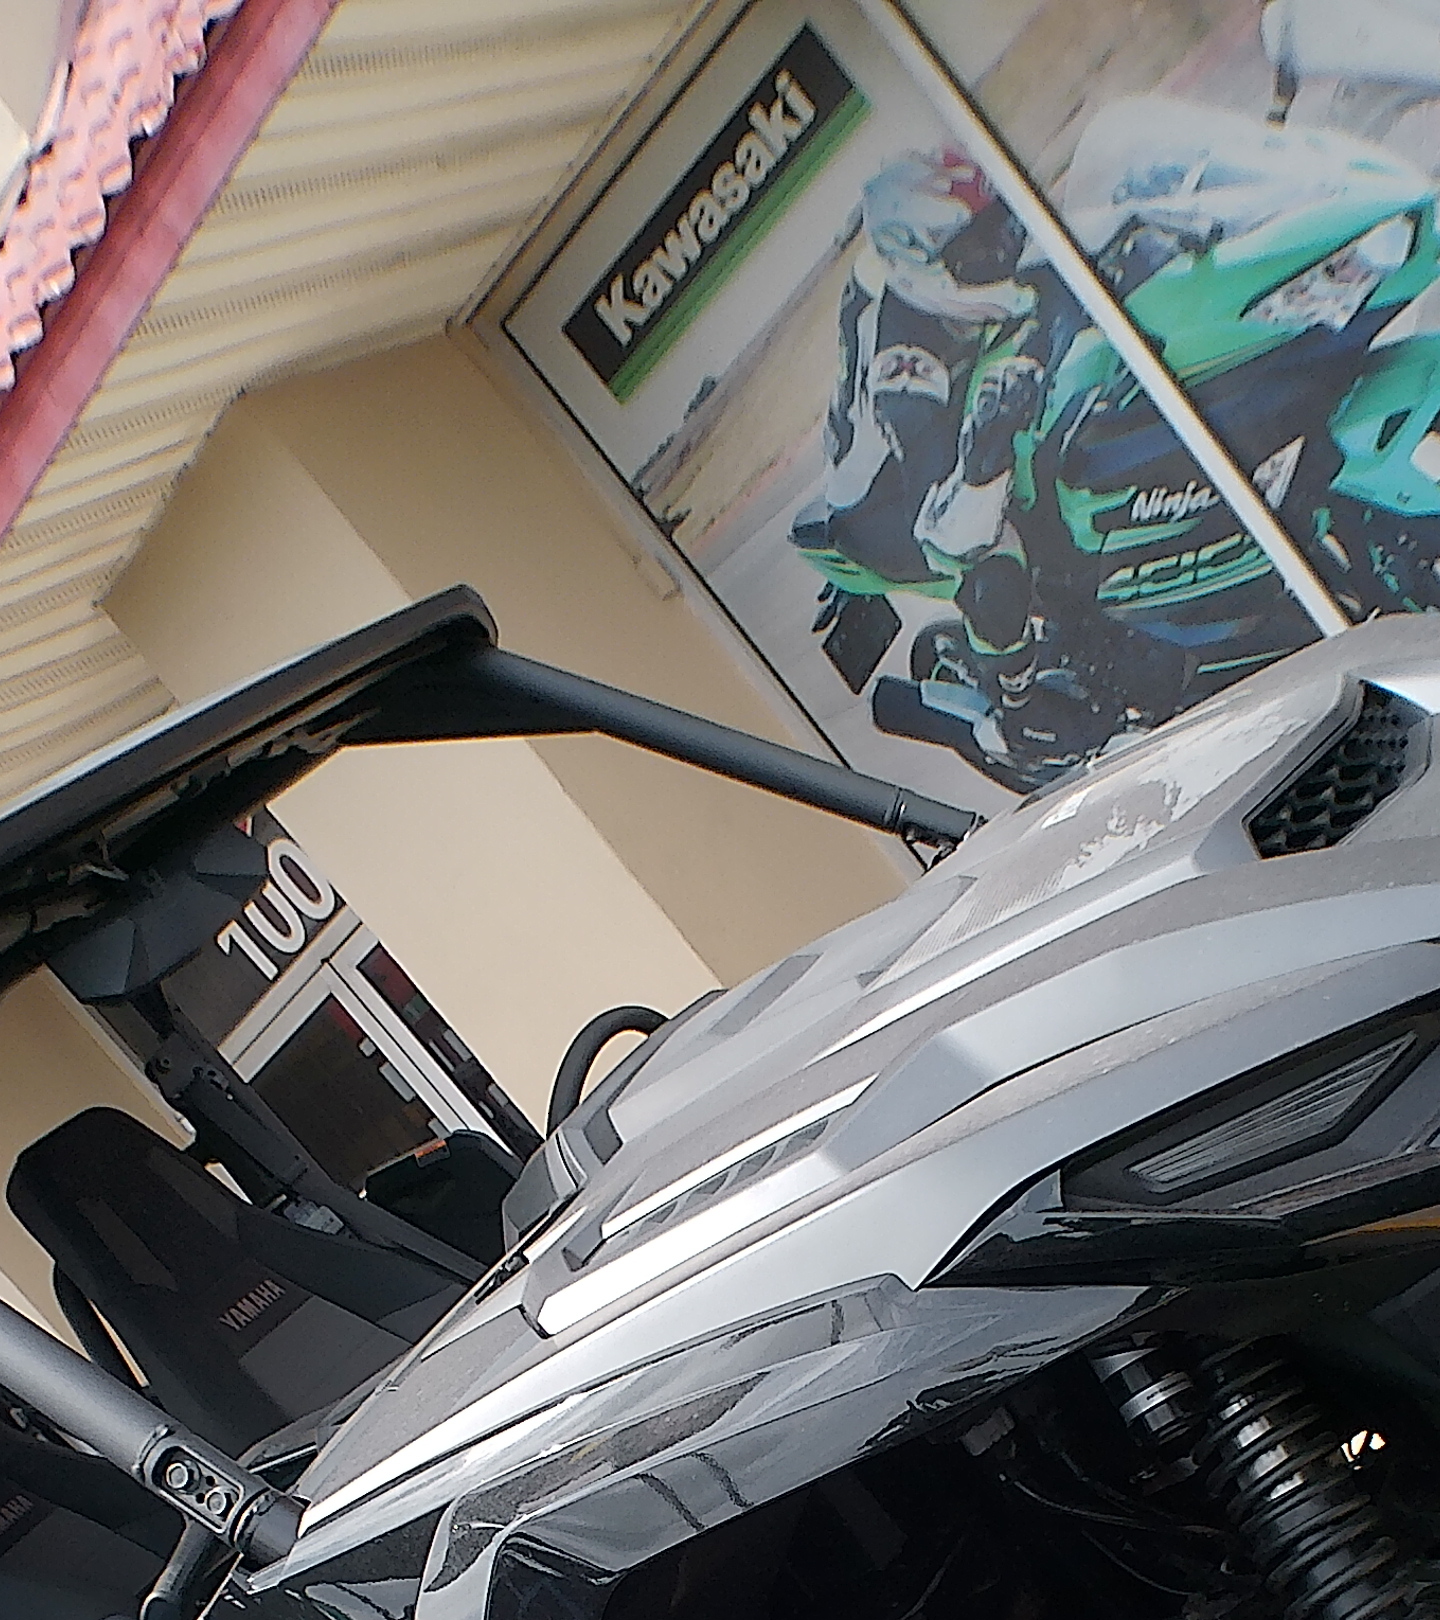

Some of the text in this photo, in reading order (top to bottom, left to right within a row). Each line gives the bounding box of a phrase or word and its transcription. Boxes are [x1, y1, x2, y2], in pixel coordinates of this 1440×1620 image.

[593, 68, 818, 349] Kawasaki
[1130, 479, 1220, 524] Ninja
[217, 1279, 286, 1331] YAMAHA
